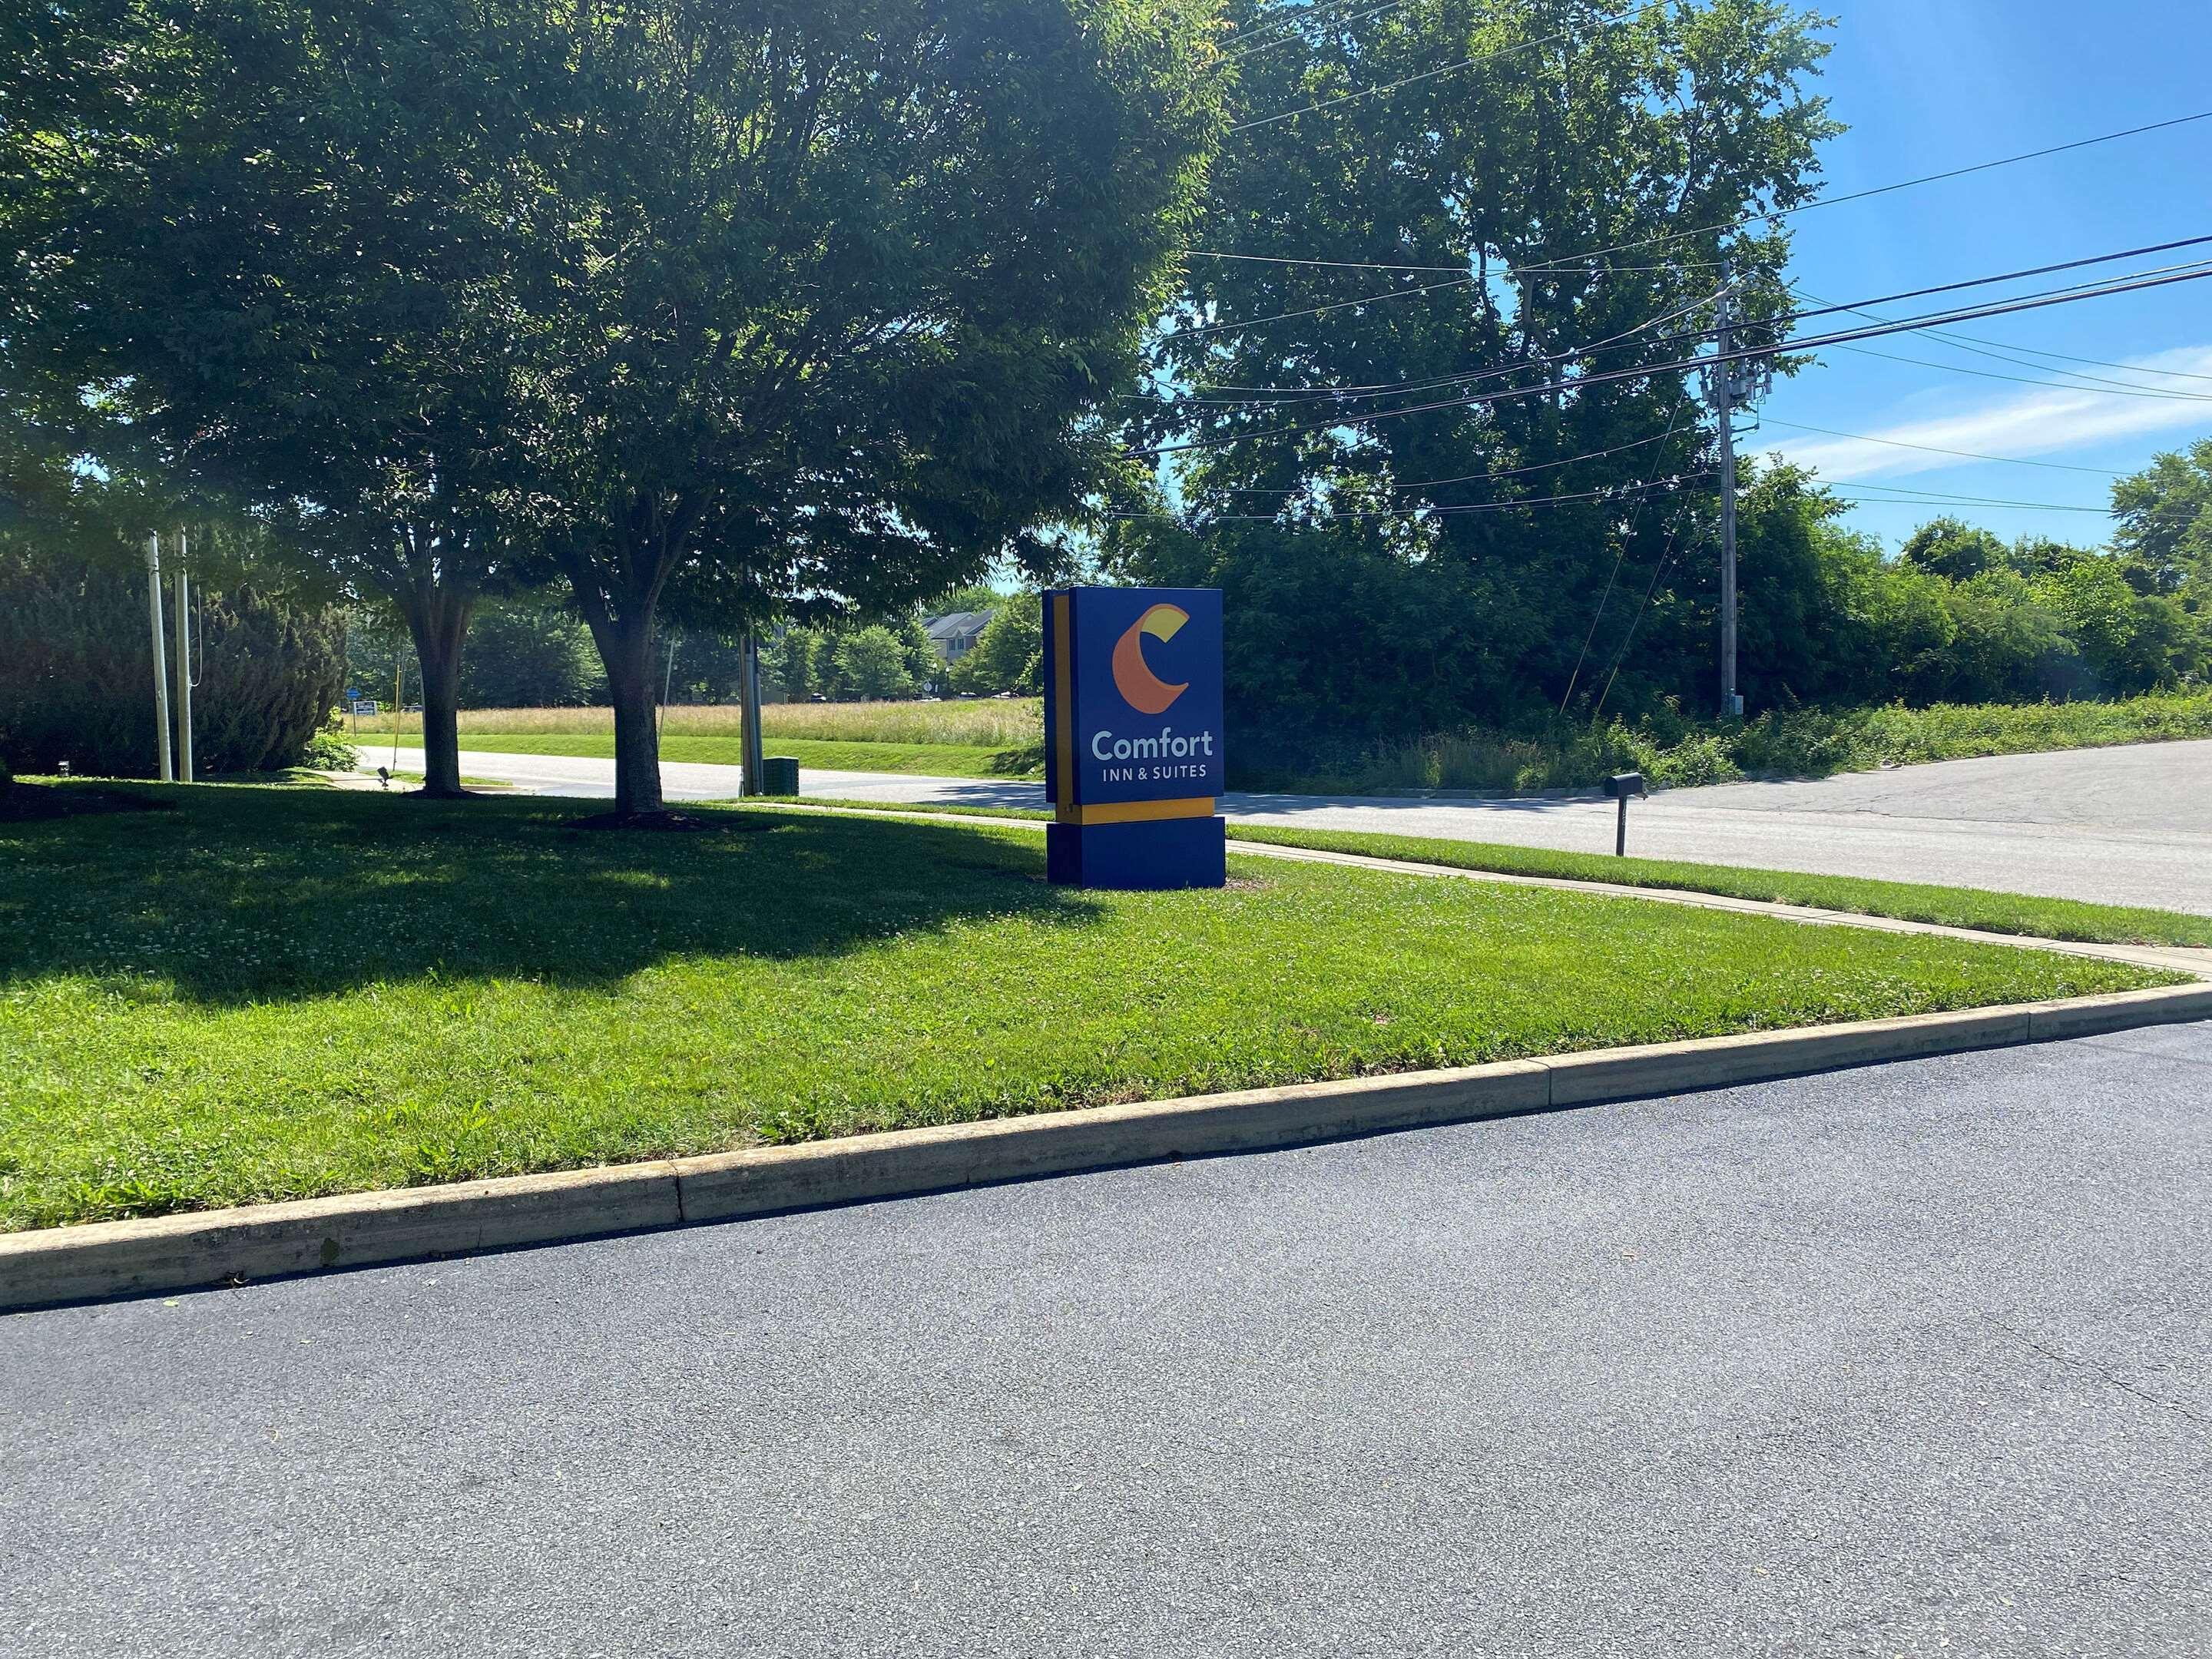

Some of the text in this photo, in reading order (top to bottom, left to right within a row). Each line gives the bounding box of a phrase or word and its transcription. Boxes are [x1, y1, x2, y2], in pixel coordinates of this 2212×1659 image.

[1091, 727, 1214, 760] Comfort
[1103, 764, 1207, 782] INN & SUITES
